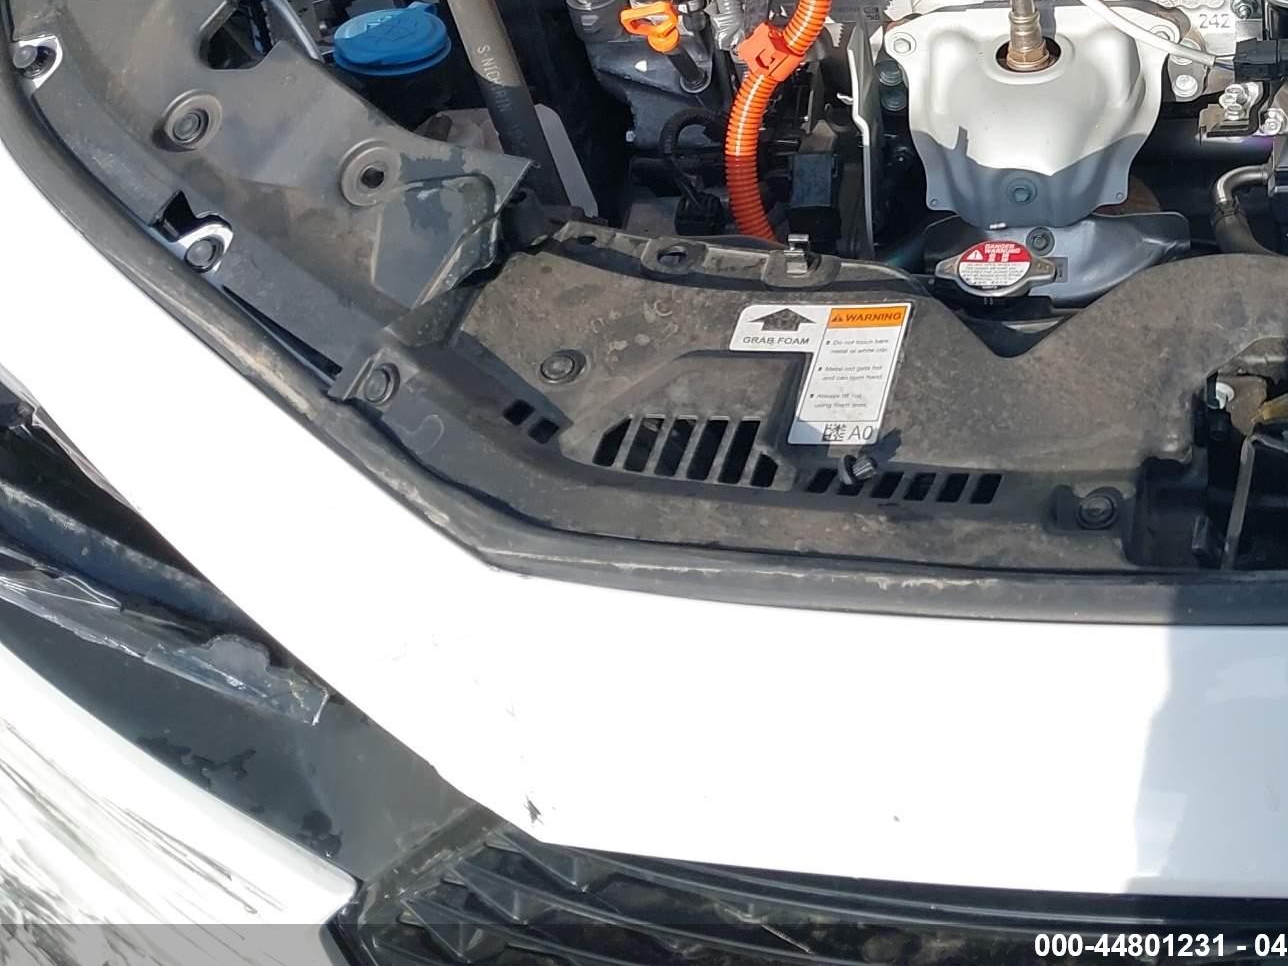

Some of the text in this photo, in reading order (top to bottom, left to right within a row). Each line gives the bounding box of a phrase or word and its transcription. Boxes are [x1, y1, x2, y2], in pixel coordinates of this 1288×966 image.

[1199, 13, 1231, 29] 242
[846, 313, 901, 322] WARNING
[742, 336, 810, 345] GRAB FOAM
[848, 425, 874, 441] A0
